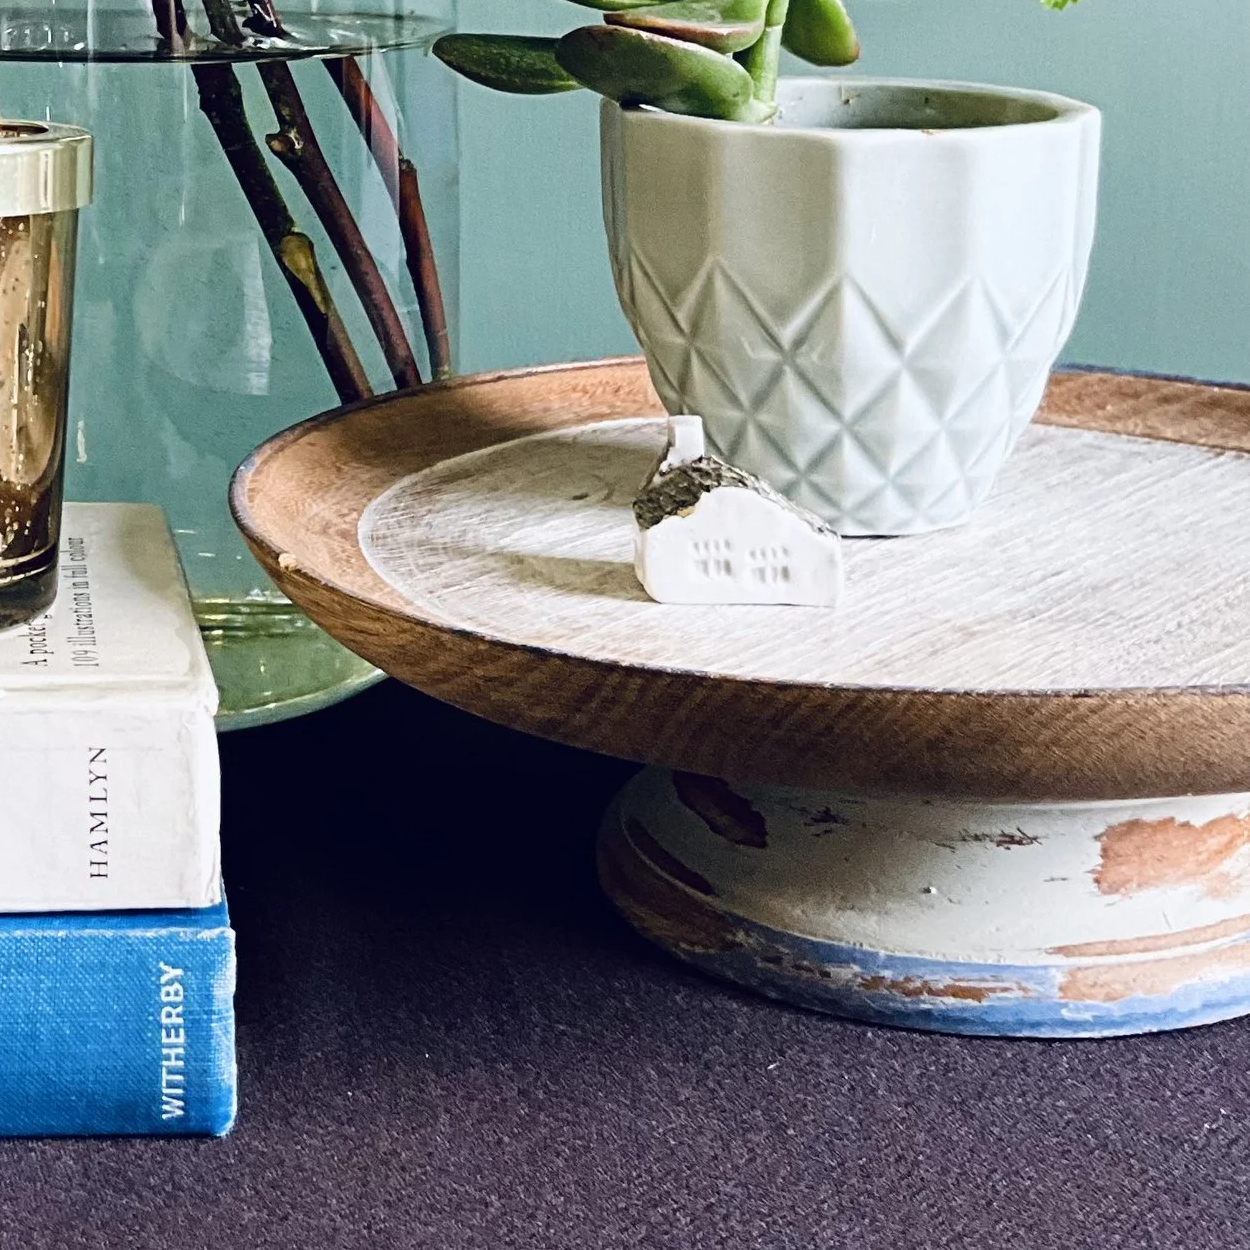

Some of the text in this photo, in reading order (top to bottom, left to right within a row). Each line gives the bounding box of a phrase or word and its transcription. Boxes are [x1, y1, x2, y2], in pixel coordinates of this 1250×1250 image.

[19, 658, 49, 667] A
[59, 536, 100, 667] 109 illustrations in full colour
[89, 746, 109, 879] HAMLYN
[158, 960, 185, 1120] WITHERBY
